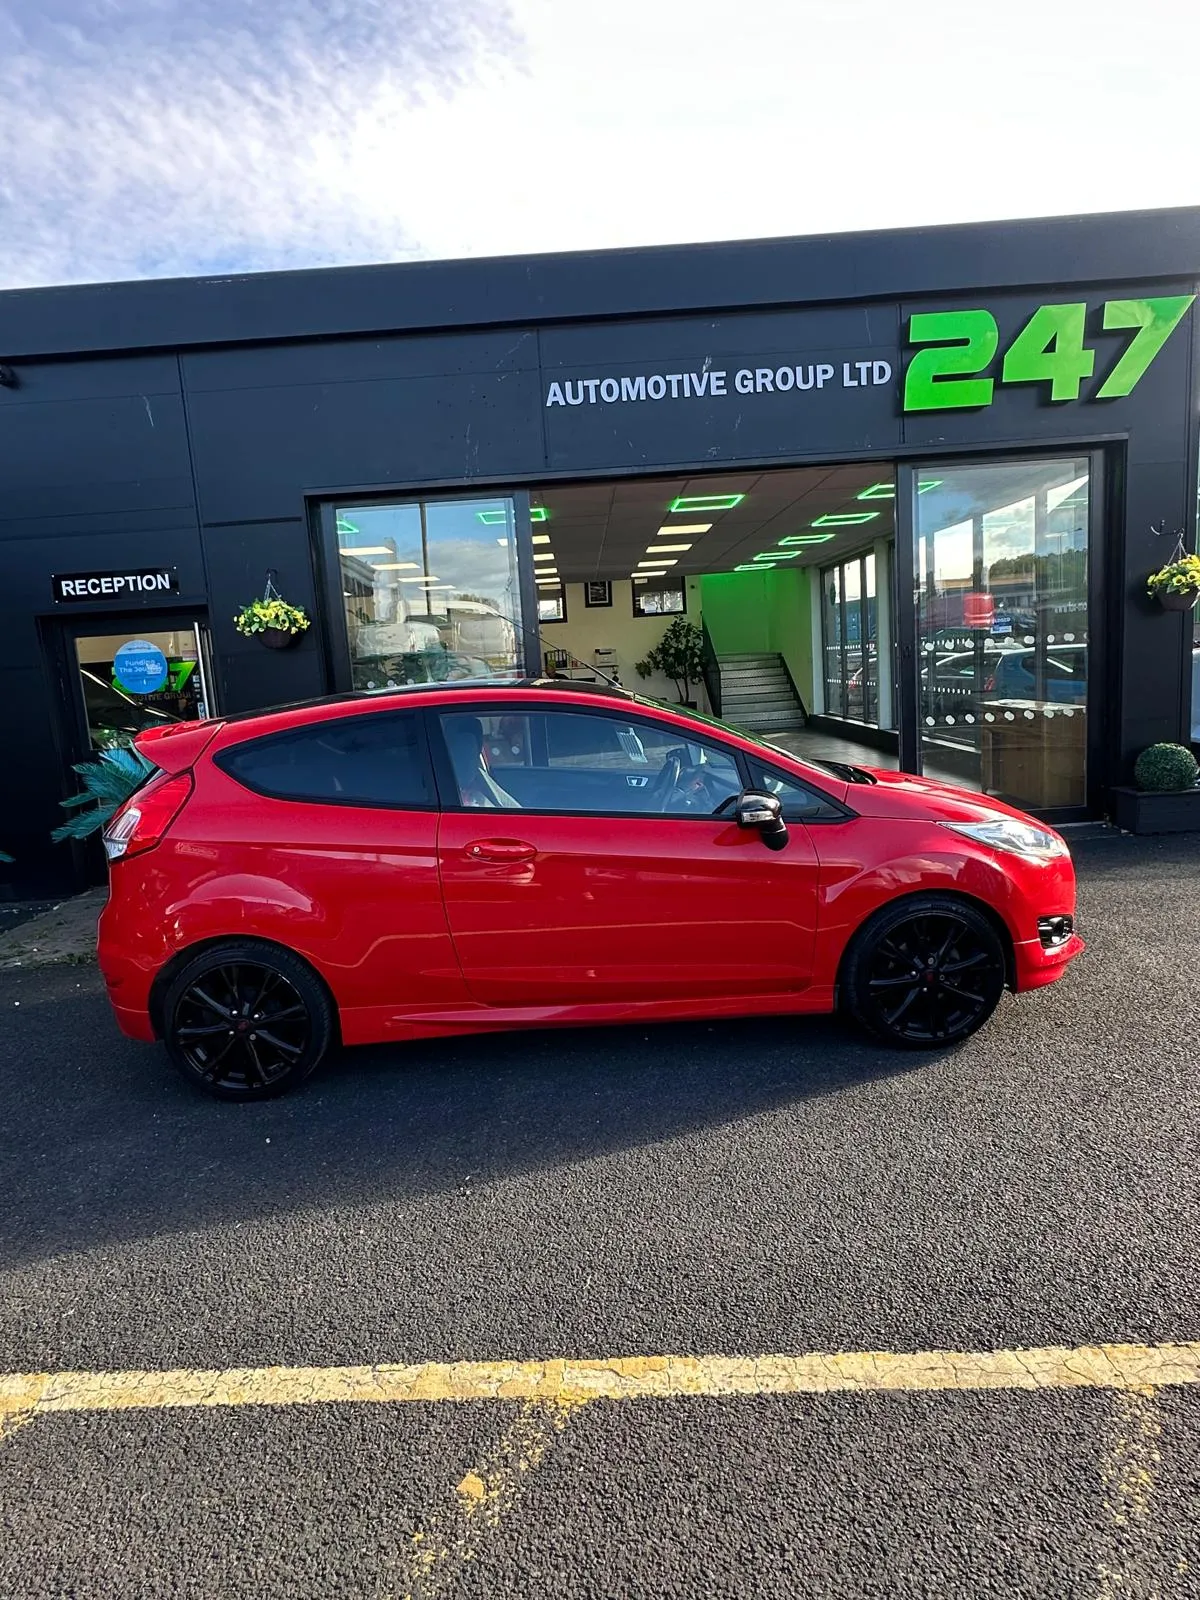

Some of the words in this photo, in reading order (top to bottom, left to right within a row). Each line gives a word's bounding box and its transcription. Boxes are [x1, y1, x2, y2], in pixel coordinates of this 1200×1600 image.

[904, 295, 1197, 411] 247
[545, 371, 727, 407] AUTOMOTIVE
[734, 363, 835, 395] GROUP
[843, 360, 892, 387] LTD
[60, 573, 171, 596] RECEPTION
